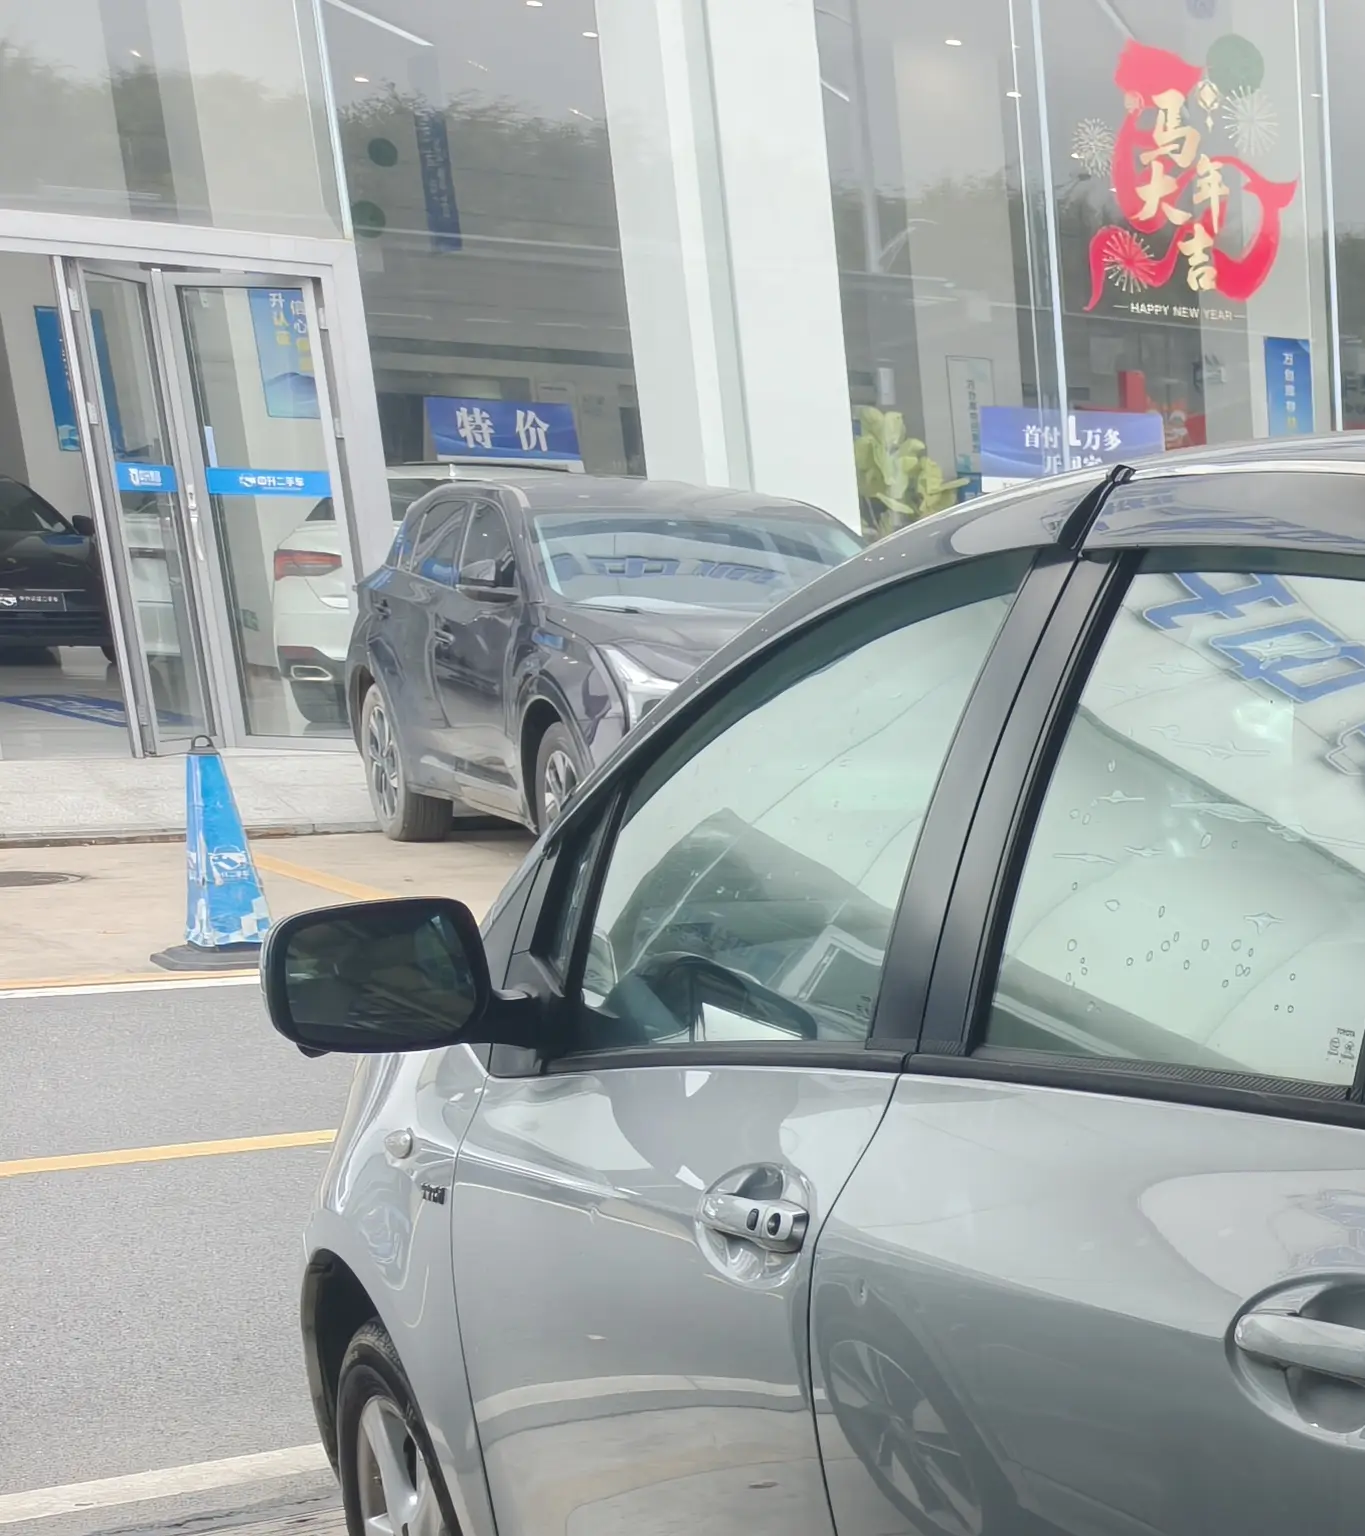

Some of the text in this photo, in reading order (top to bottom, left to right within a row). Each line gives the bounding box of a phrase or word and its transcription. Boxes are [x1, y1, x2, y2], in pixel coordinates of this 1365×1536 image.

[1130, 302, 1233, 321] HAPPY NEW YEAR
[456, 407, 550, 452] 特价
